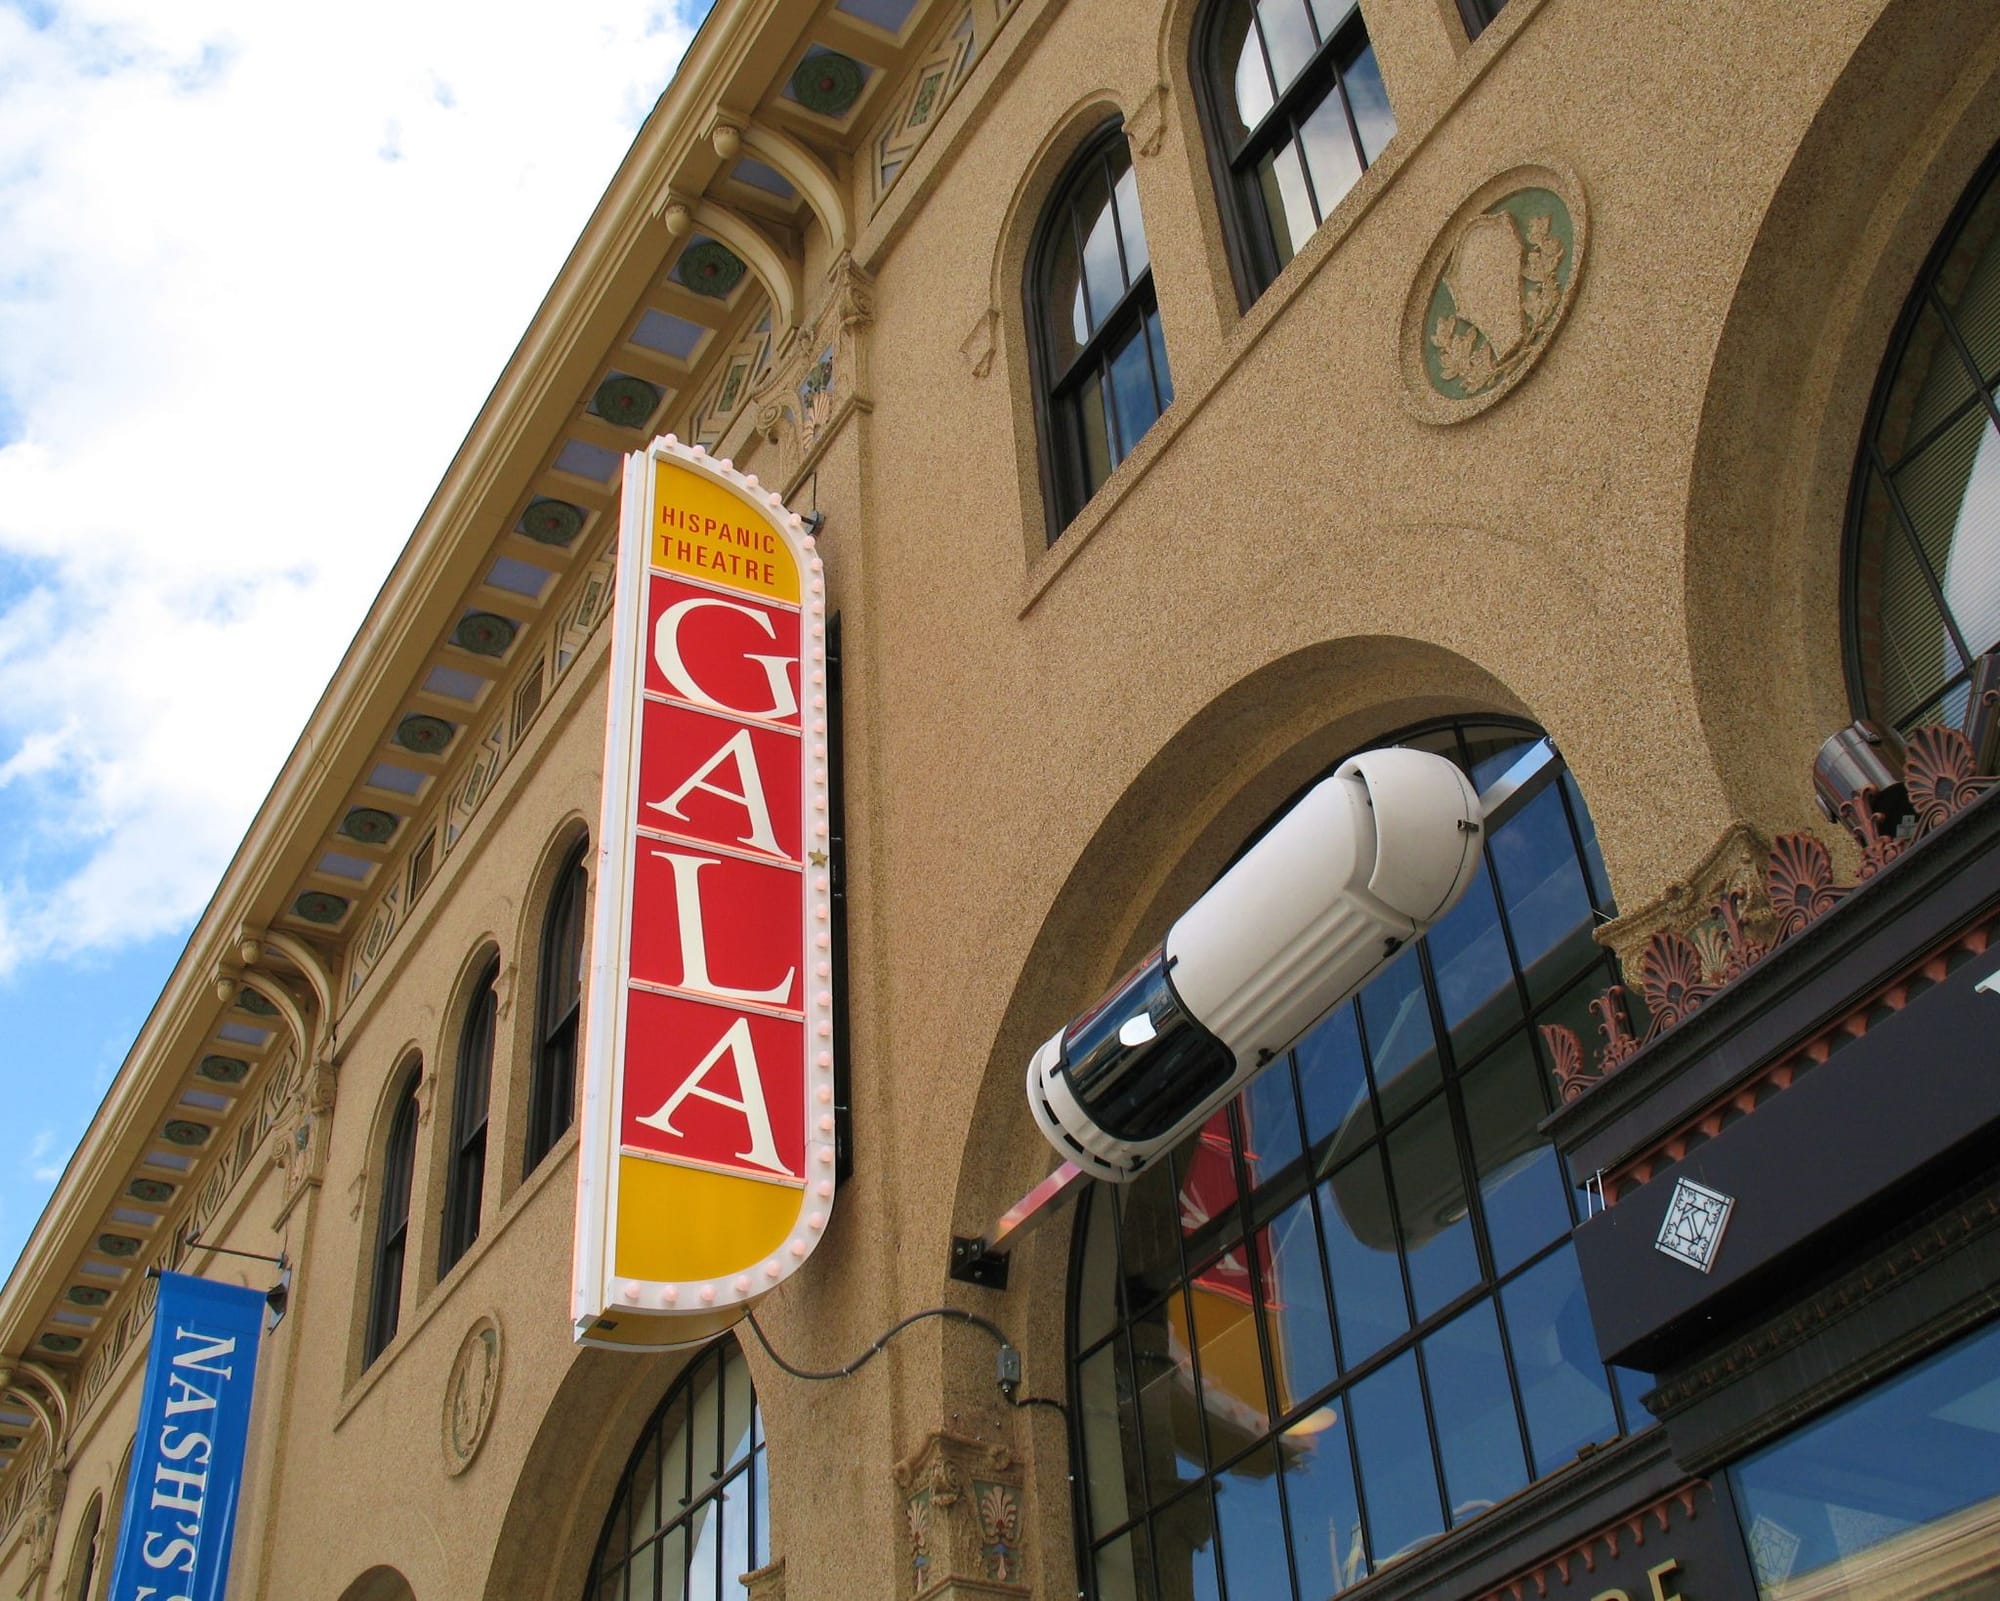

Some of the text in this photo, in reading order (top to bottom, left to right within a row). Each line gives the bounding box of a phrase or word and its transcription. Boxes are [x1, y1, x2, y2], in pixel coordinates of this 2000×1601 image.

[660, 534, 776, 586] THEATRE
[662, 505, 776, 555] HISPANIC
[635, 597, 799, 1177] GALA
[142, 1325, 236, 1572] NASH'S
